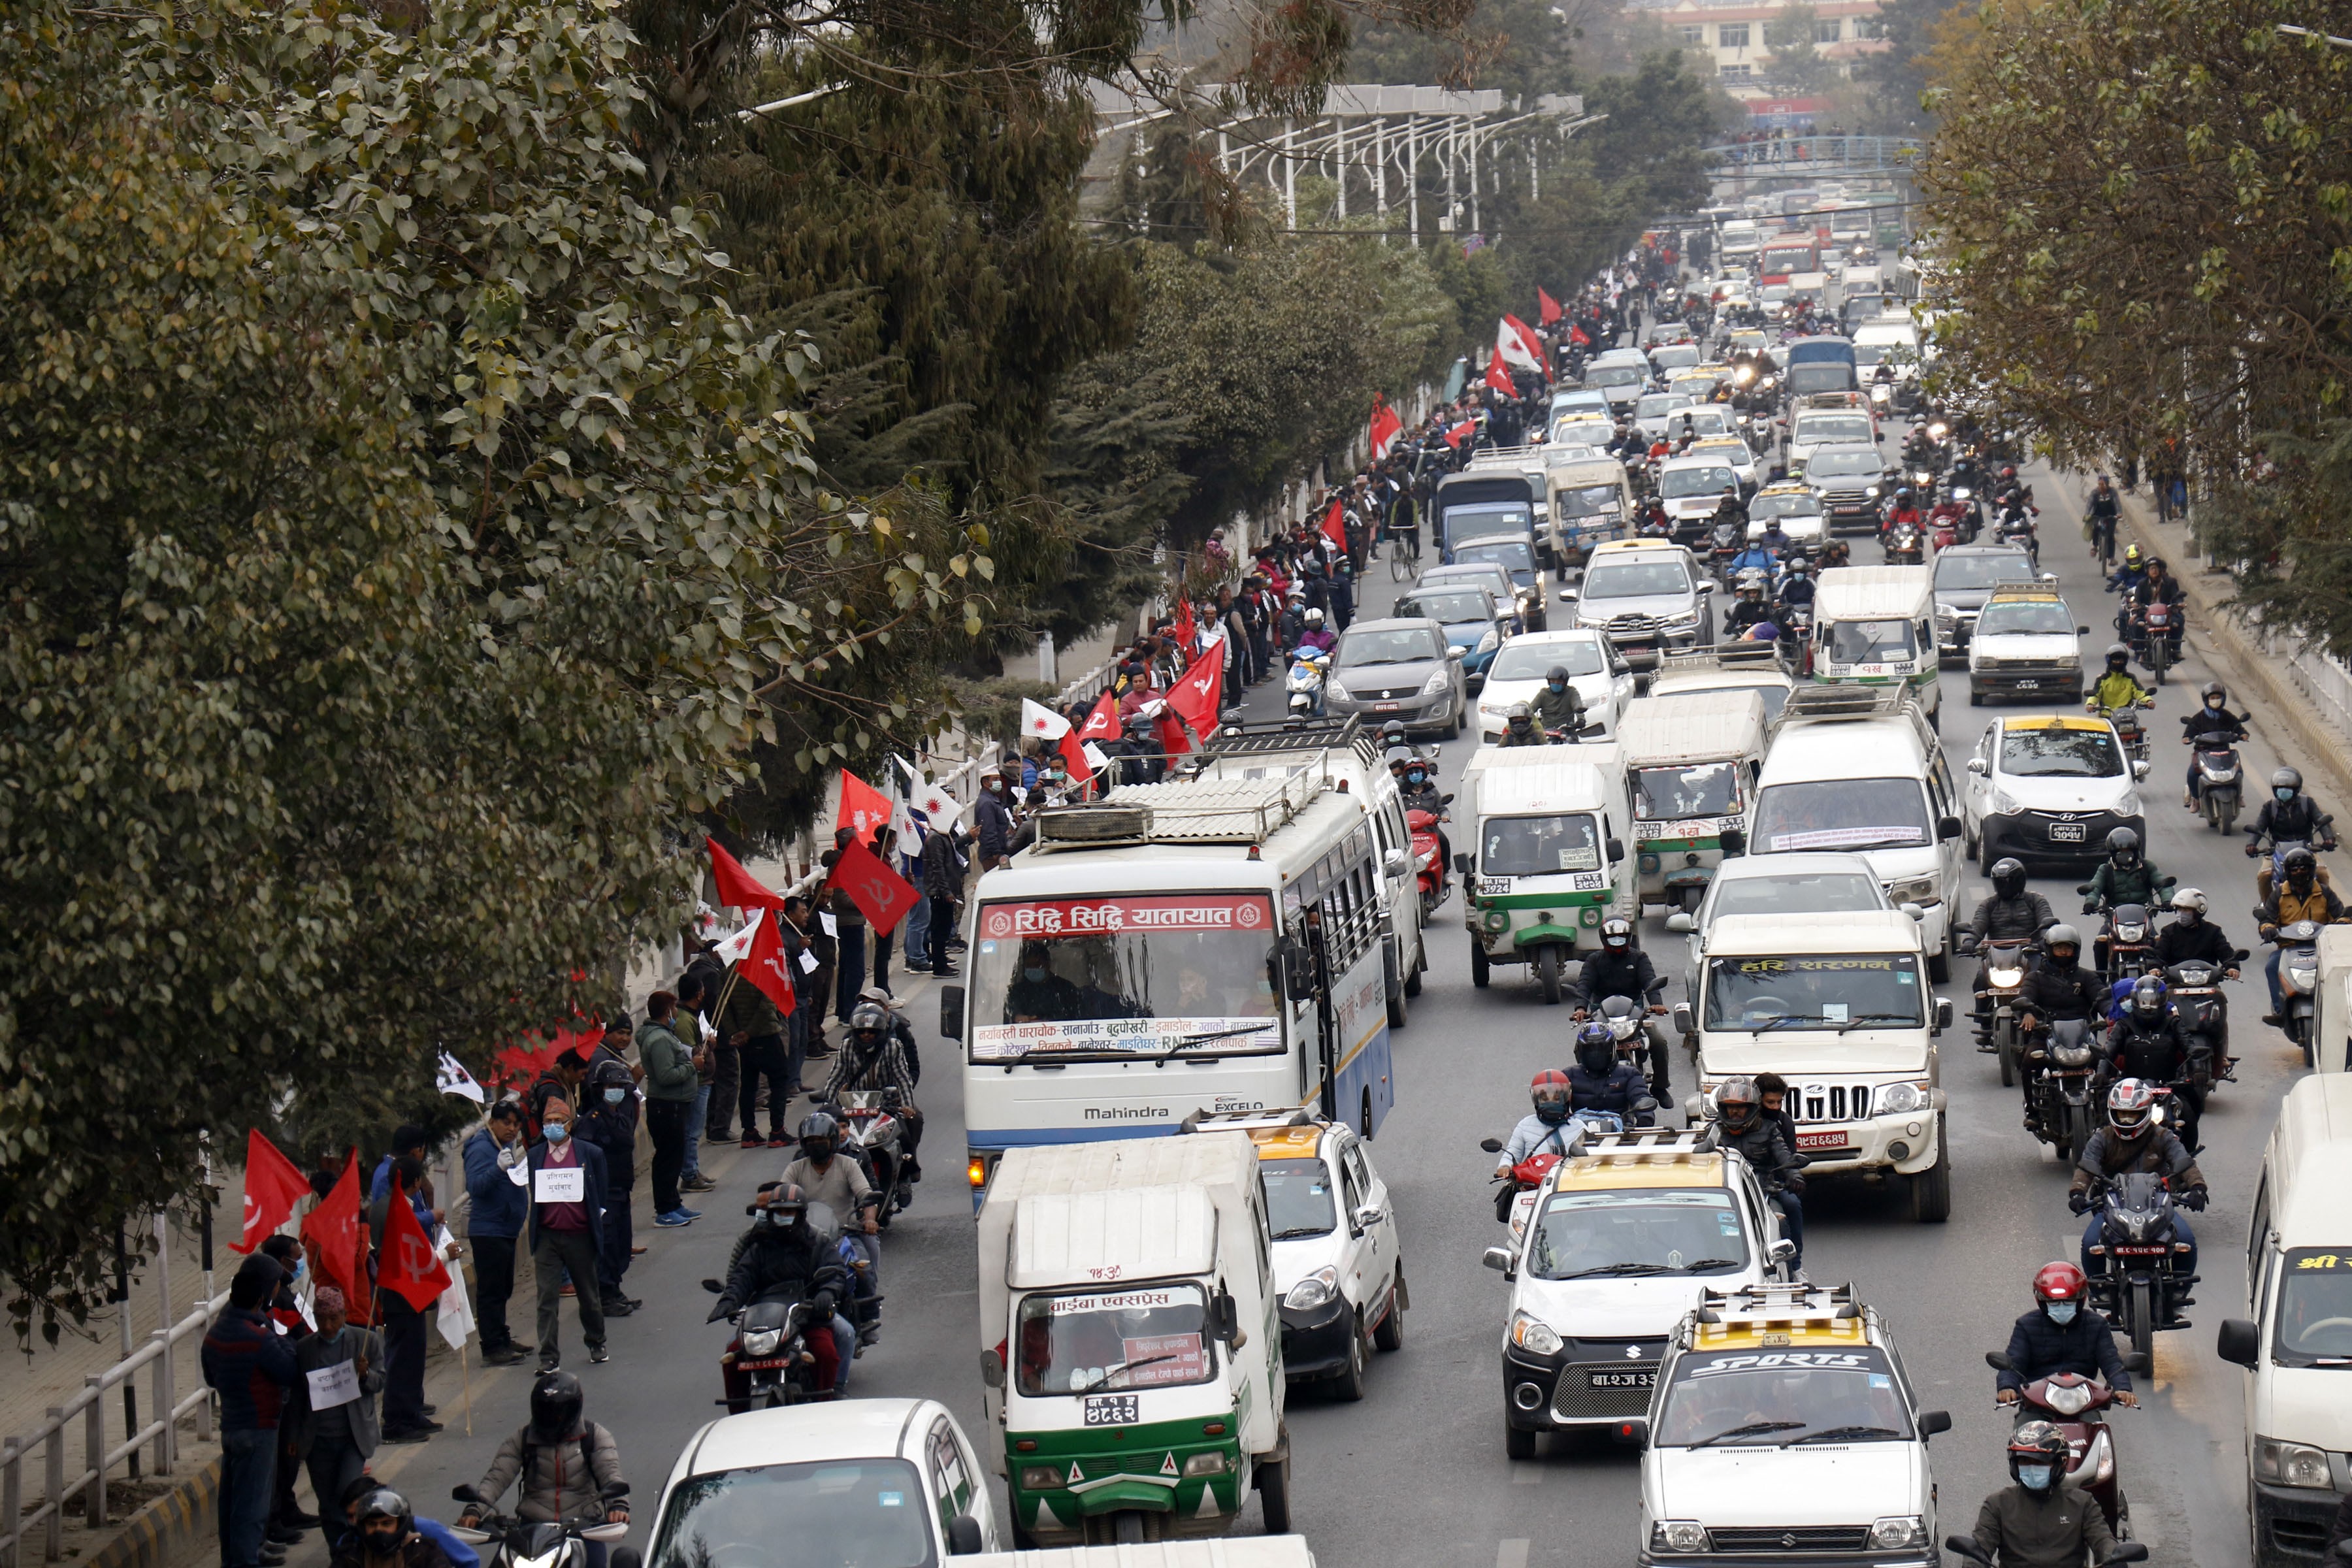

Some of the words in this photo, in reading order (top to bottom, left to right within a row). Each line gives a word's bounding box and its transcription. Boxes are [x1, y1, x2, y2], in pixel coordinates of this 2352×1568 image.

[1483, 885, 1509, 893] 3924
[1015, 908, 1062, 933] रिद्धि
[1070, 906, 1124, 930] सिद्धि
[1132, 907, 1233, 924] यातायात
[1740, 960, 1787, 972] हरि
[1085, 1107, 1168, 1119] Mahindra
[1215, 1102, 1264, 1112] EXCELO
[2296, 1255, 2340, 1269] श्री
[1102, 1293, 1169, 1307] एक्सप्रेस
[1691, 1353, 1869, 1374] SPORTS
[1086, 1407, 1135, 1422] ४८६२
